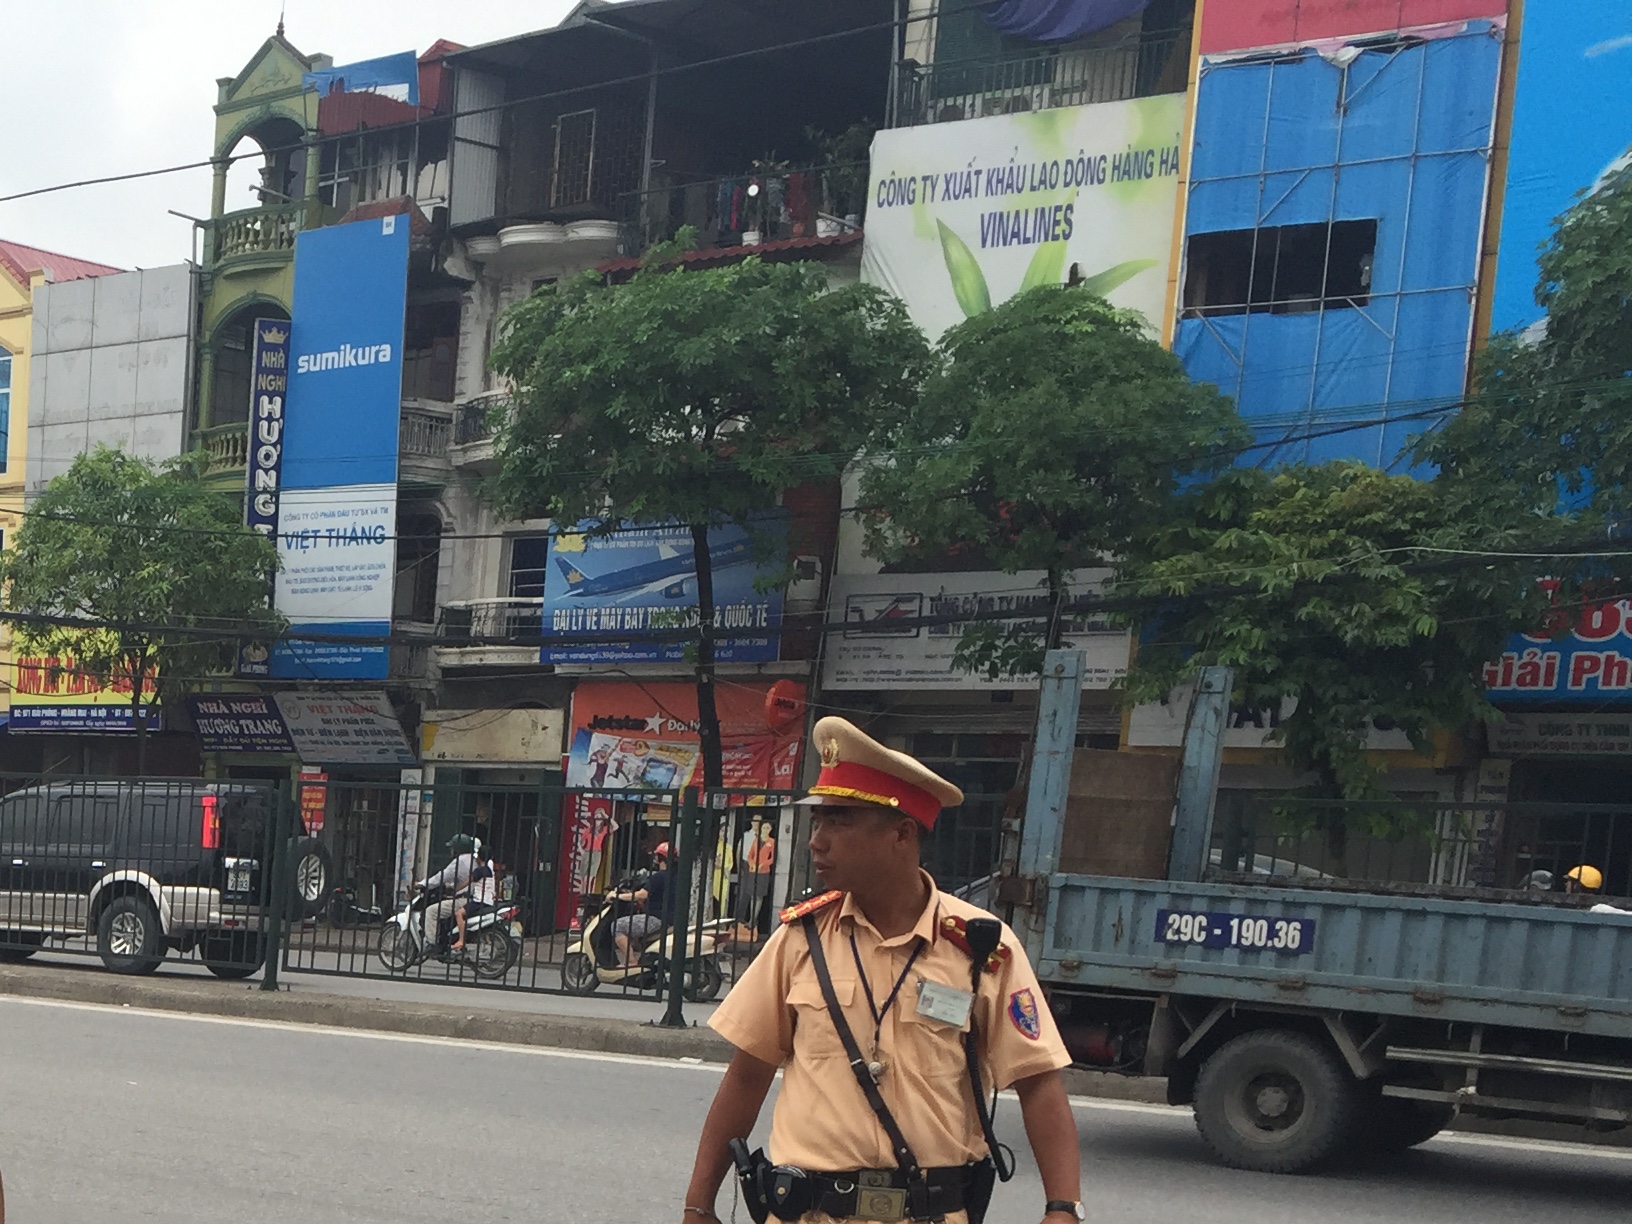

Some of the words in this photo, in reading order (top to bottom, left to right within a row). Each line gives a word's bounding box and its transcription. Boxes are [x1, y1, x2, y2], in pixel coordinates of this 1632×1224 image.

[877, 171, 916, 208] CÔNG
[921, 175, 940, 204] TY
[941, 157, 983, 202] XUẤT
[985, 146, 1027, 197] KHẨU
[1029, 160, 1060, 192] LAO
[1063, 149, 1107, 197] ĐỘNG
[1110, 144, 1154, 183] HÀNG
[979, 203, 1074, 248] VINALINES
[262, 347, 285, 368] NHÀ
[297, 344, 391, 373] sumikura
[258, 370, 287, 391] NGHỈ
[285, 528, 321, 554] VIỆT
[326, 522, 386, 548] THẮNG
[624, 606, 644, 630] BAY
[724, 597, 752, 628] QUỐC
[196, 699, 230, 714] NHÀ
[230, 698, 268, 714] NGHỈ
[196, 717, 239, 735] HƯƠNG
[239, 719, 282, 735] TRANG
[1167, 913, 1208, 943] 29C
[1230, 917, 1302, 949] 190.36
